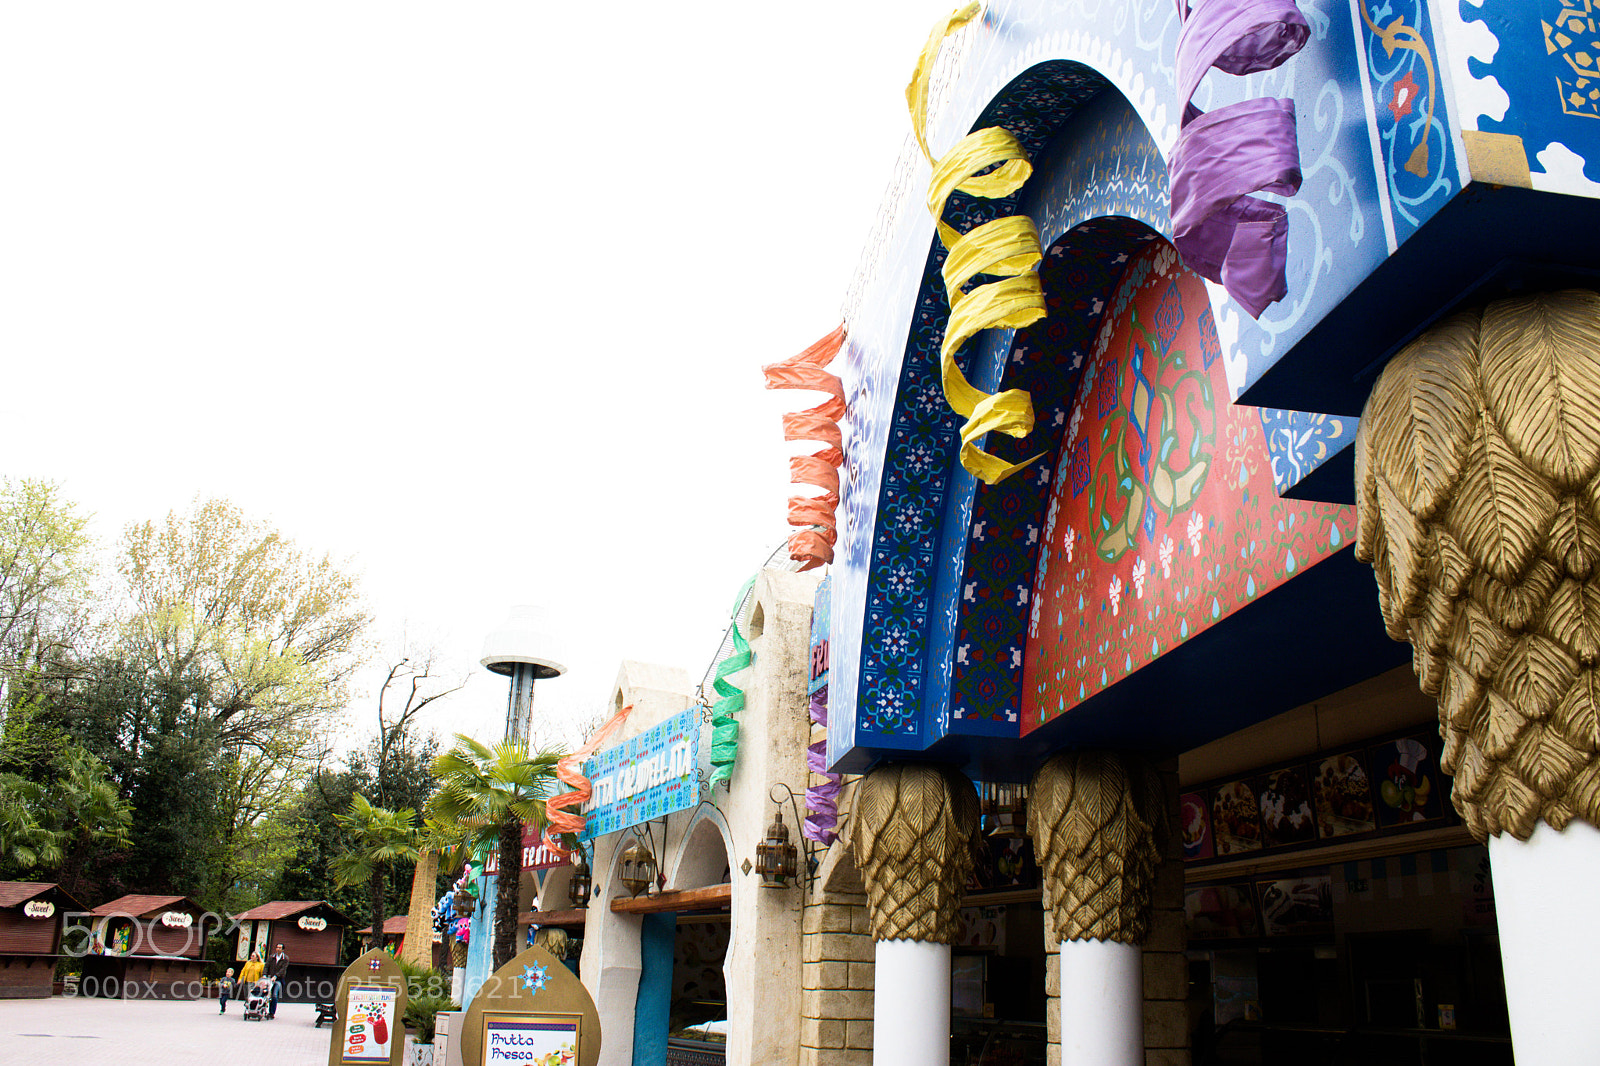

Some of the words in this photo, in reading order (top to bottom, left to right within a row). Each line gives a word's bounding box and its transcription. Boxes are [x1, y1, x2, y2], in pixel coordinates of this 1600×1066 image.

[616, 740, 692, 801] CARAMELLATA
[31, 903, 49, 913] Sweet
[304, 918, 321, 927] Sweet
[491, 1032, 534, 1046] Frutta
[491, 1047, 533, 1060] Fresca
